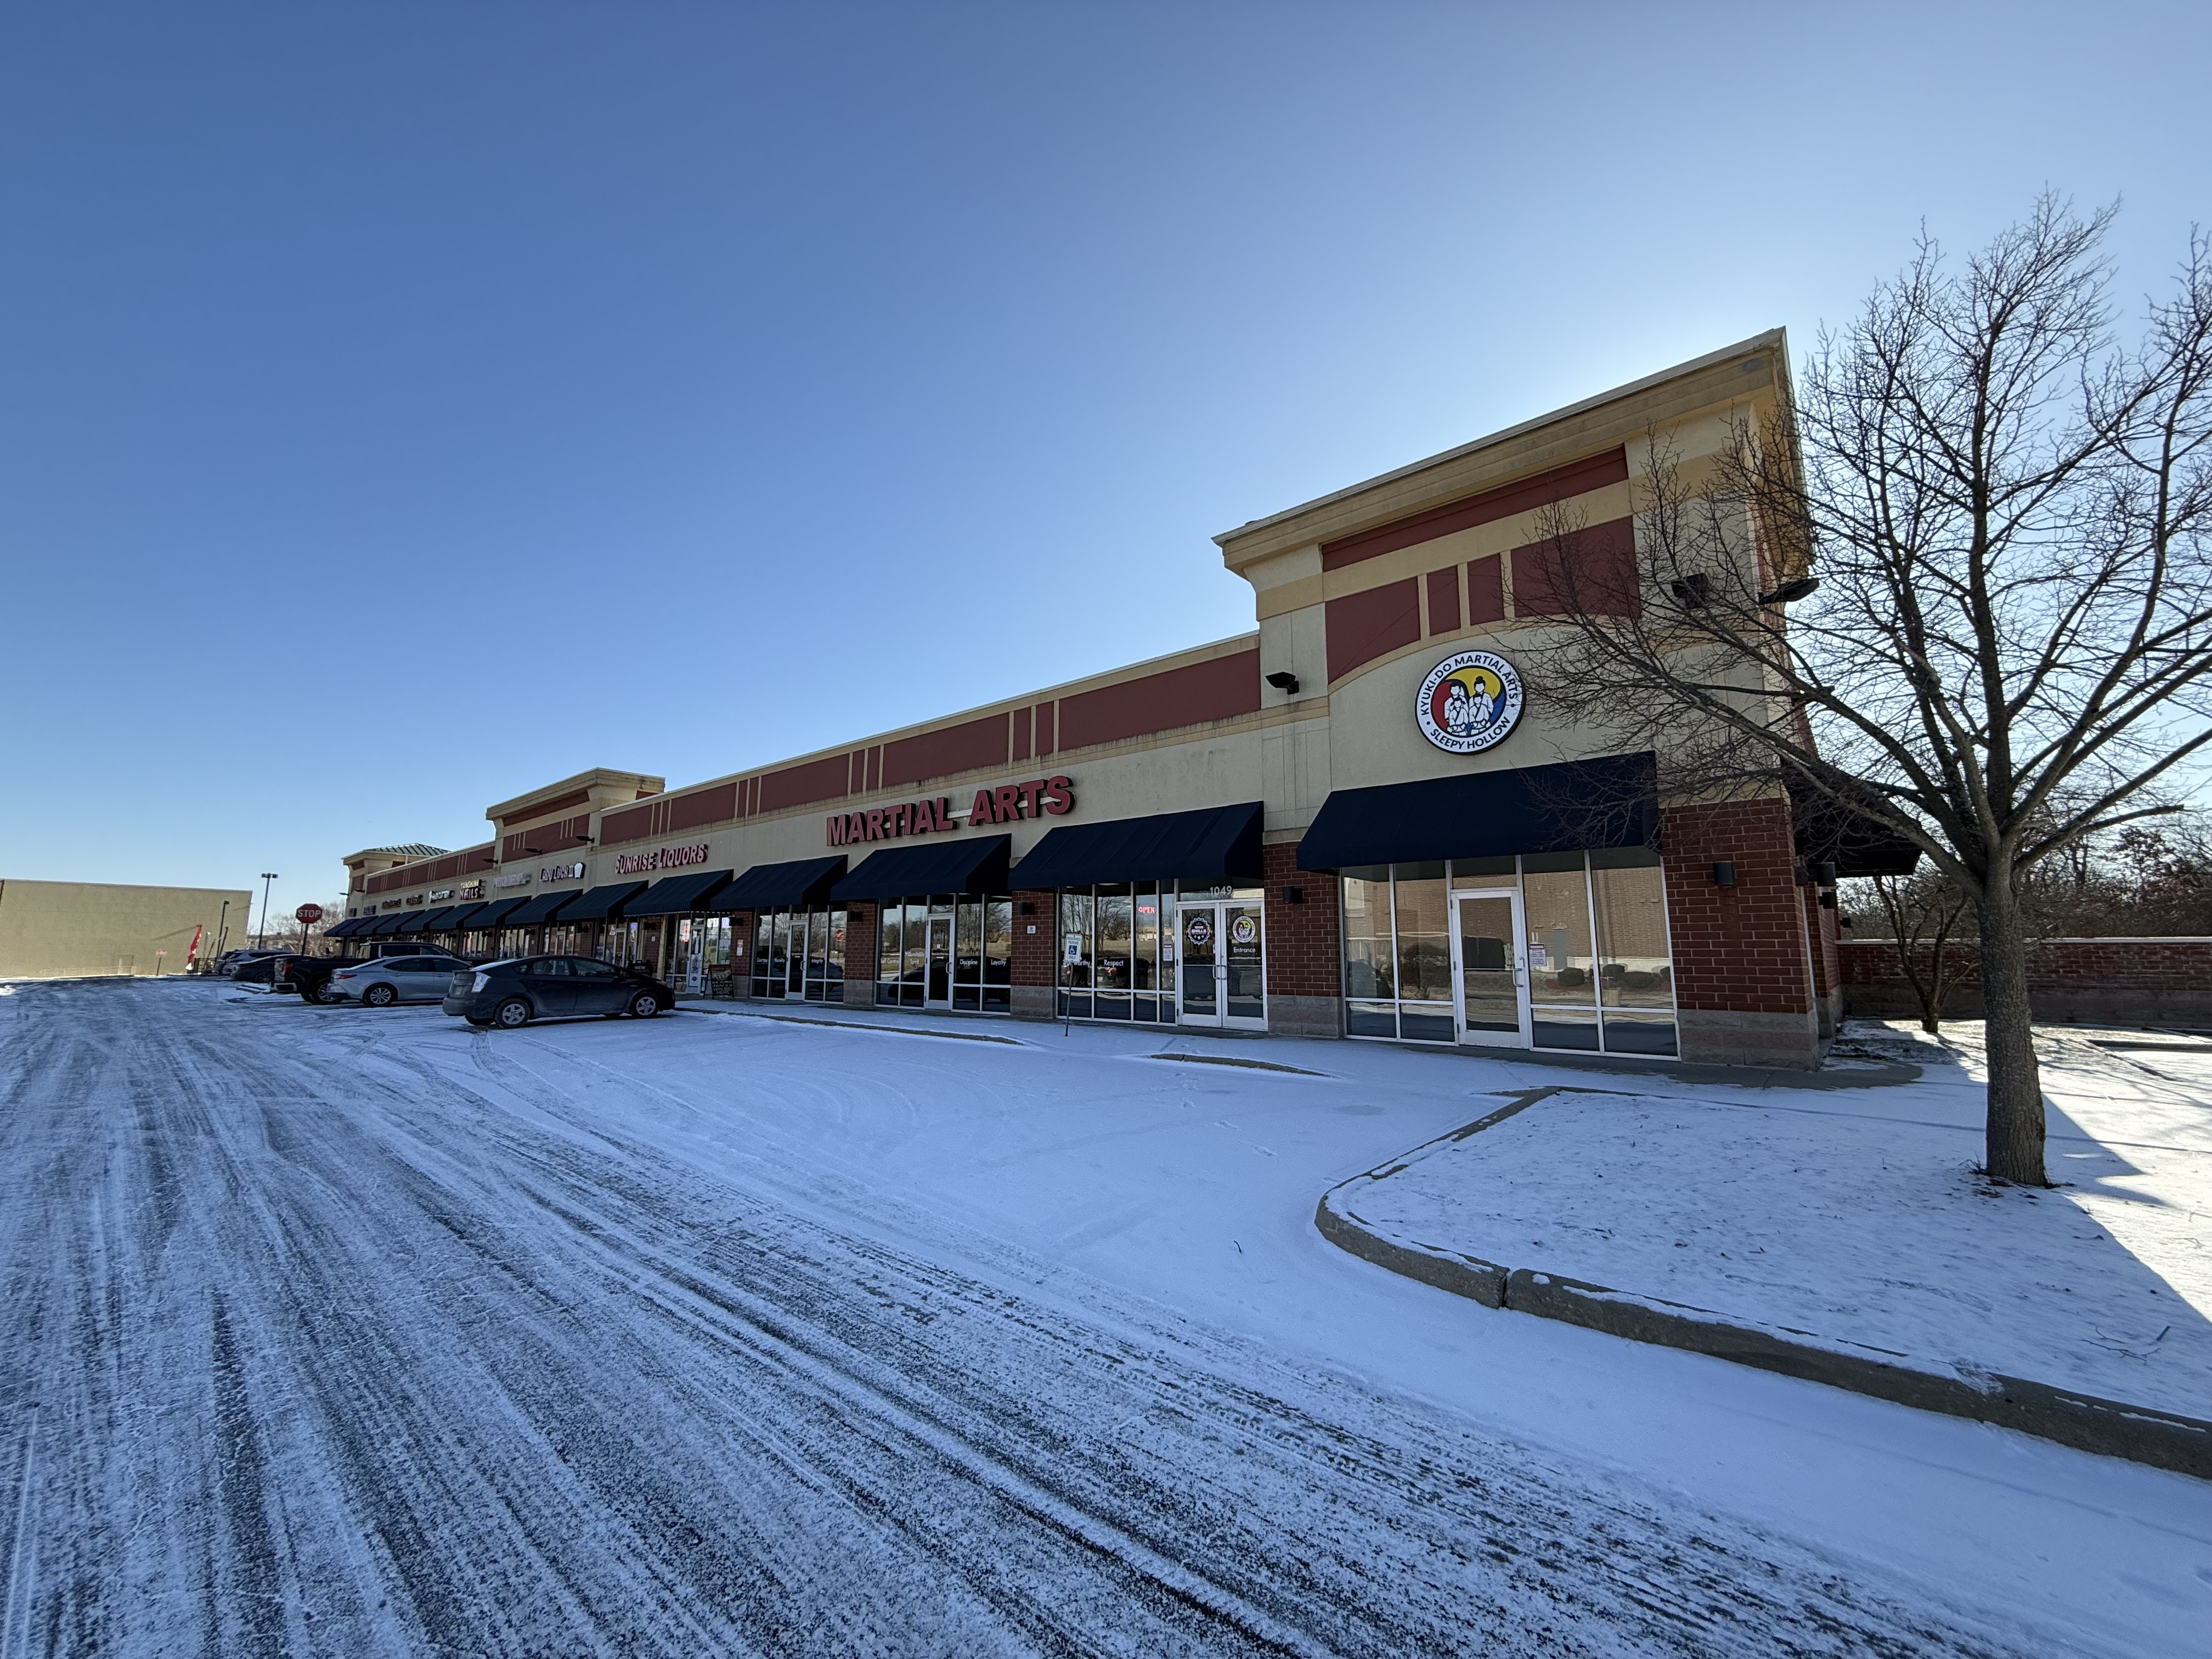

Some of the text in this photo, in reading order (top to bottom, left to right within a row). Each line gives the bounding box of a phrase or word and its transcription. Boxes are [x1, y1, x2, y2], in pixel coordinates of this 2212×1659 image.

[1420, 655, 1518, 715] KYUKI-DO MARTIAL ARTS
[1430, 716, 1510, 749] SLEEPY HOLLOW
[827, 775, 1074, 847] MARTIAL ARTS
[615, 844, 707, 873] SUNRISE LIQUORS
[554, 865, 568, 879] LUCK
[459, 888, 478, 900] NAILS
[1210, 885, 1232, 896] 1049
[297, 909, 321, 918] STOP
[991, 958, 1006, 967] Loyalty
[1104, 960, 1124, 968] Respect
